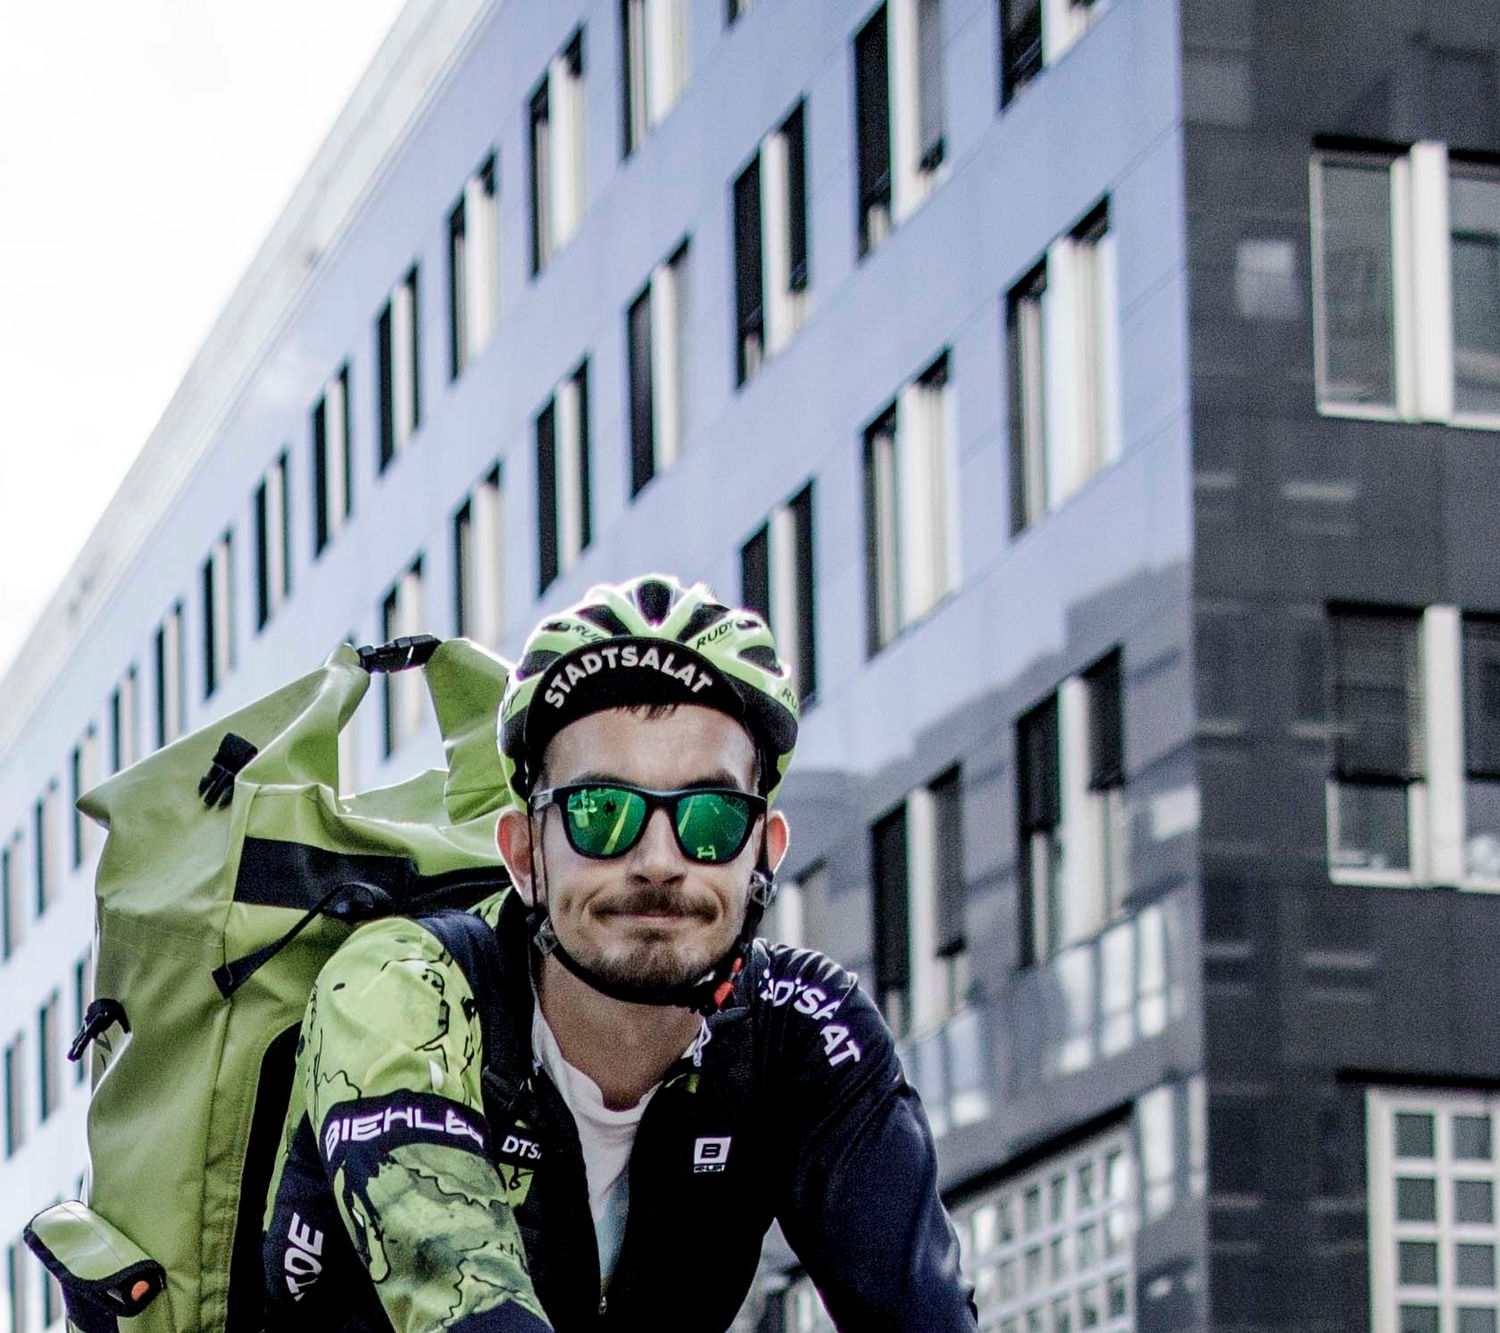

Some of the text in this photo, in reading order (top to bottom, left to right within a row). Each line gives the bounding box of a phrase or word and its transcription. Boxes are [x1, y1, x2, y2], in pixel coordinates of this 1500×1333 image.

[695, 619, 734, 650] RUDY
[545, 646, 713, 709] STADTSALAT
[501, 1134, 543, 1160] DTS
